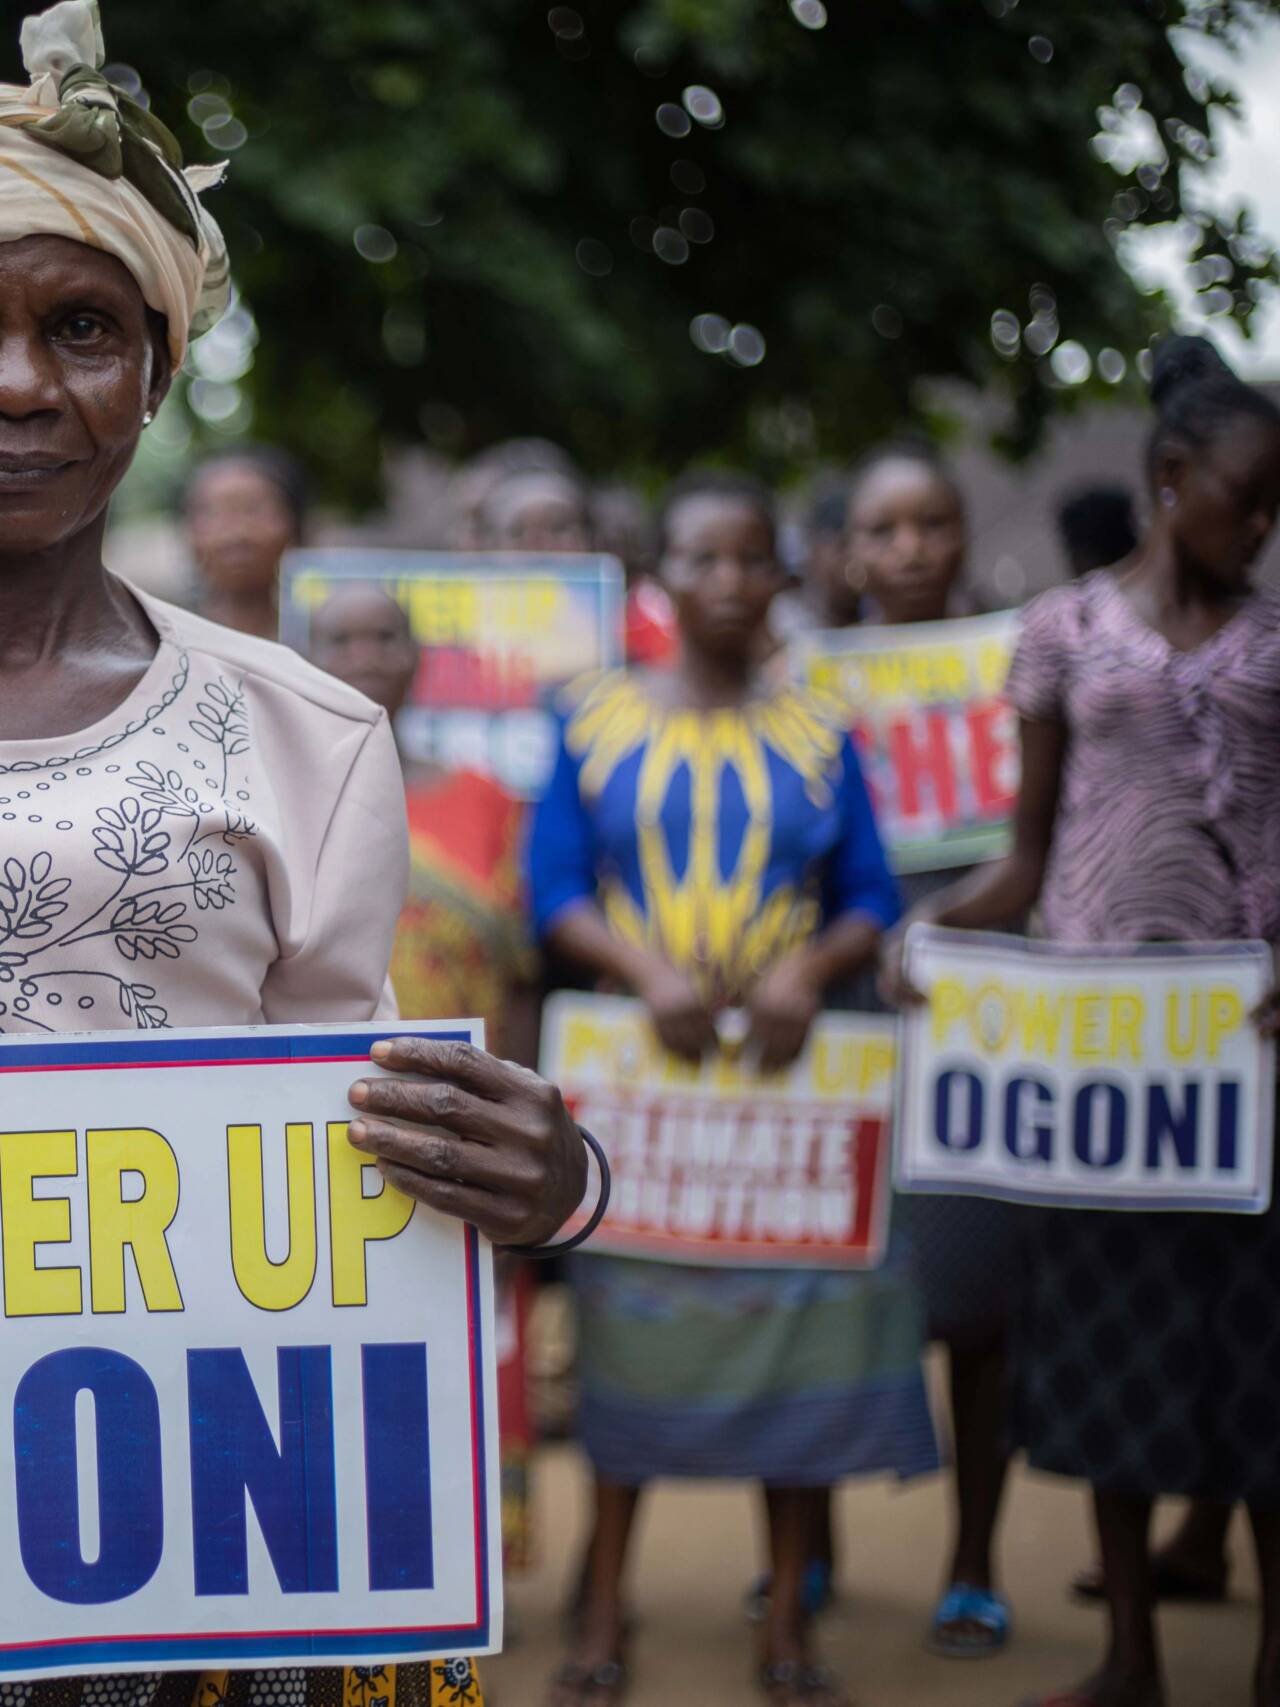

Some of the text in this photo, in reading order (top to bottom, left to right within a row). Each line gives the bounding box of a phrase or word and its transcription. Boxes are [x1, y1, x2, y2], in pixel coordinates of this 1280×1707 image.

[930, 977, 1244, 1061] POWER UP
[935, 1069, 1241, 1169] OGONI
[226, 1121, 417, 1312] UP
